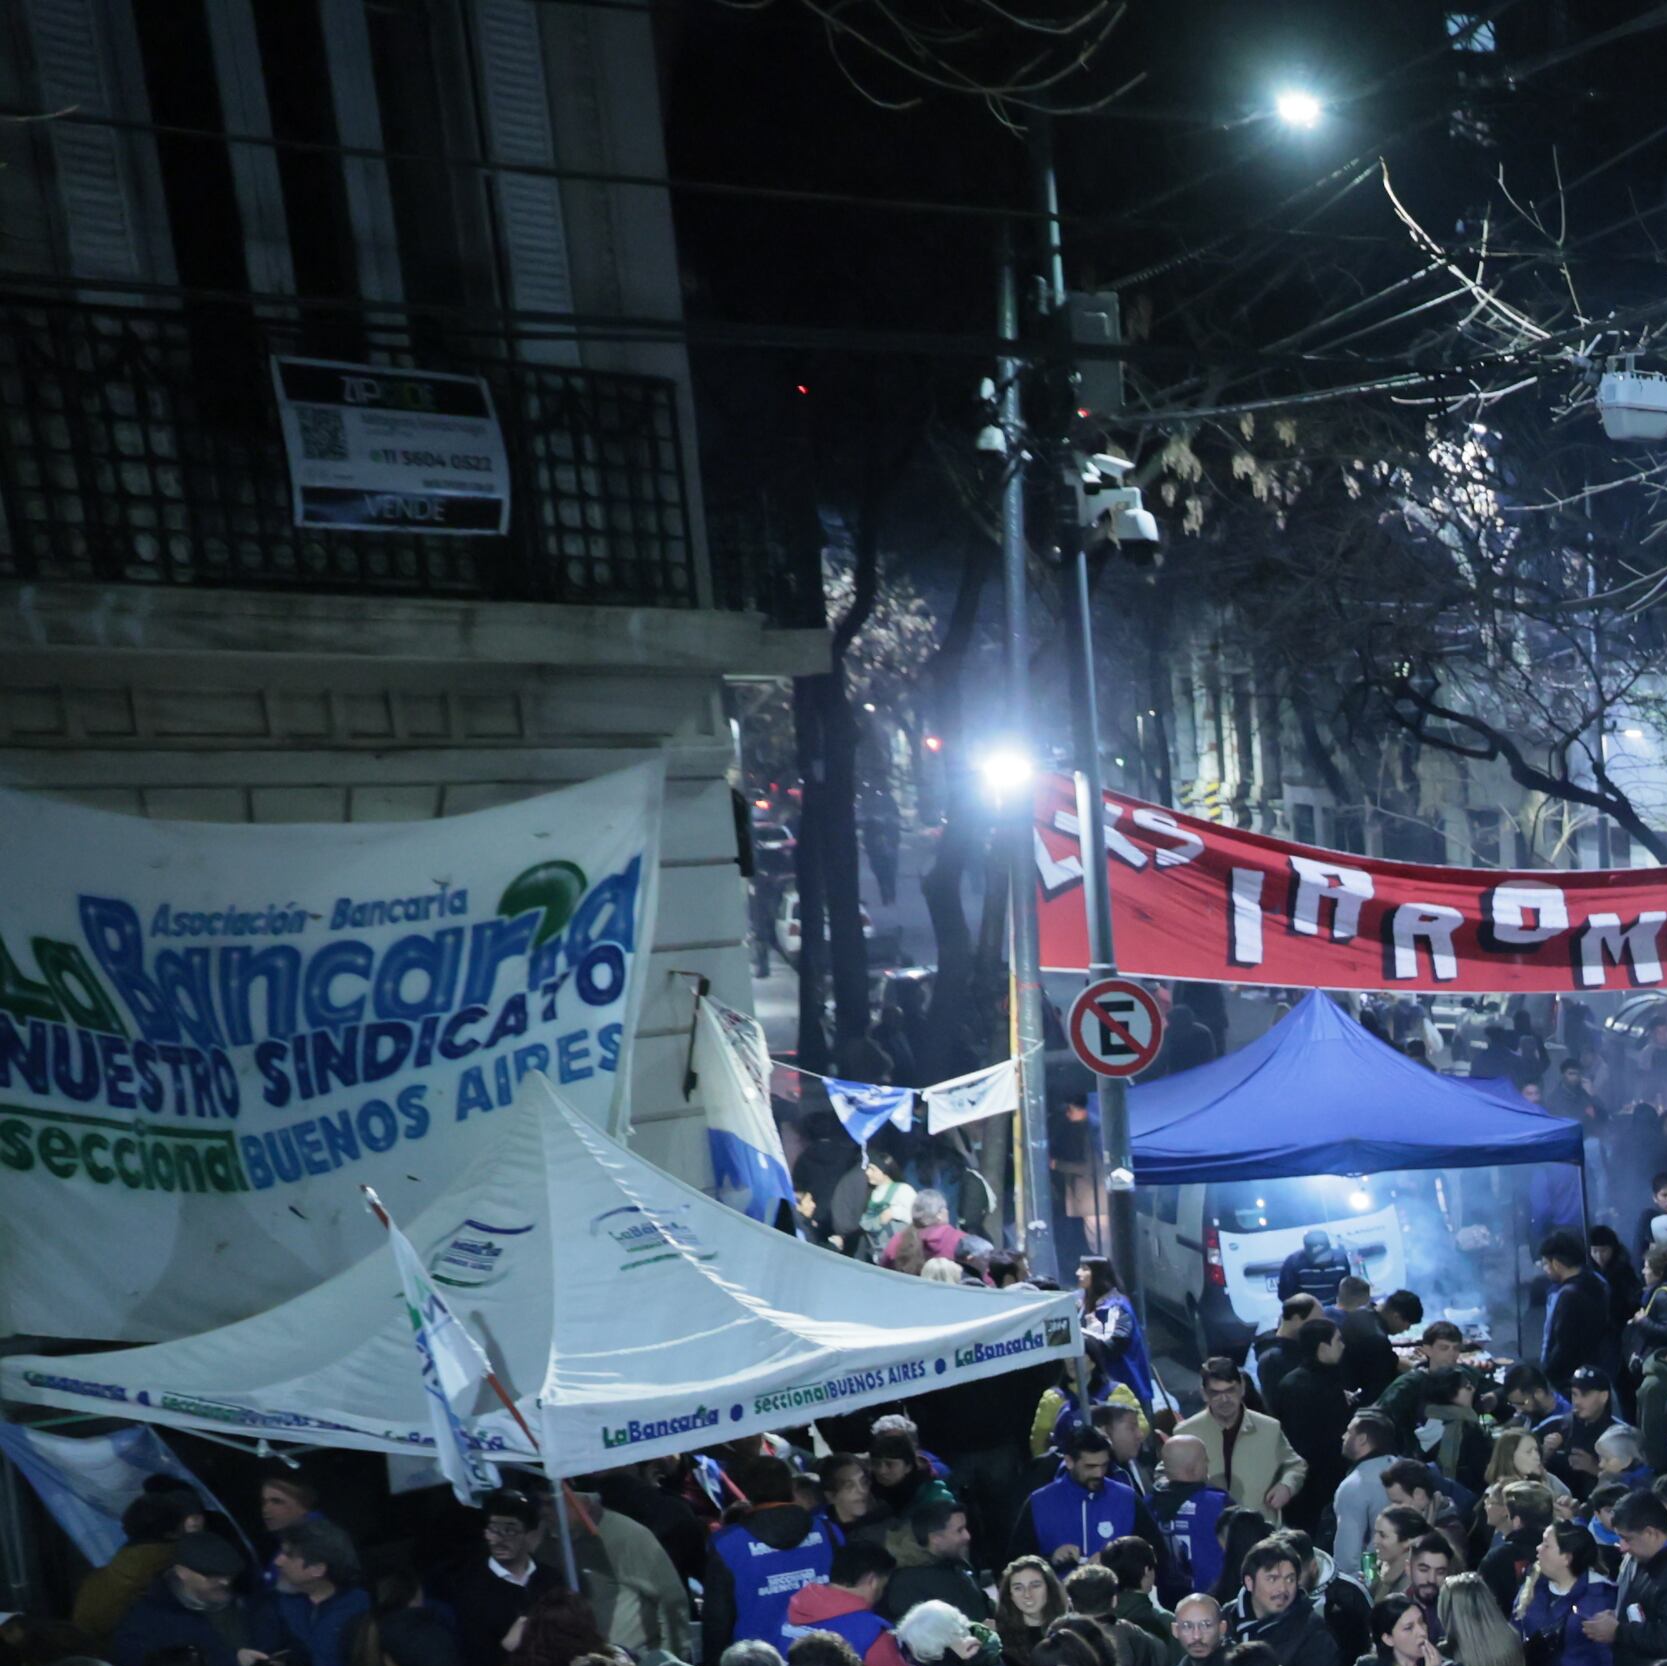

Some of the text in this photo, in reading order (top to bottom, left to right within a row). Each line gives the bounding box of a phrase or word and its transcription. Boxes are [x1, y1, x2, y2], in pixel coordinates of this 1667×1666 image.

[364, 493, 446, 522] VENDE
[77, 853, 641, 1050] Bancaria
[151, 885, 468, 938] Asociación Bancaria
[0, 944, 626, 1120] NUESTRO SINDICATO
[1100, 1000, 1135, 1055] E
[240, 1084, 430, 1190] BUENOS
[455, 1022, 624, 1122] AIRES
[602, 1405, 720, 1449] LaBancaria
[827, 1370, 885, 1399] BUENOS
[887, 1359, 927, 1386] AIRES
[954, 1329, 1045, 1369] LaBancaria
